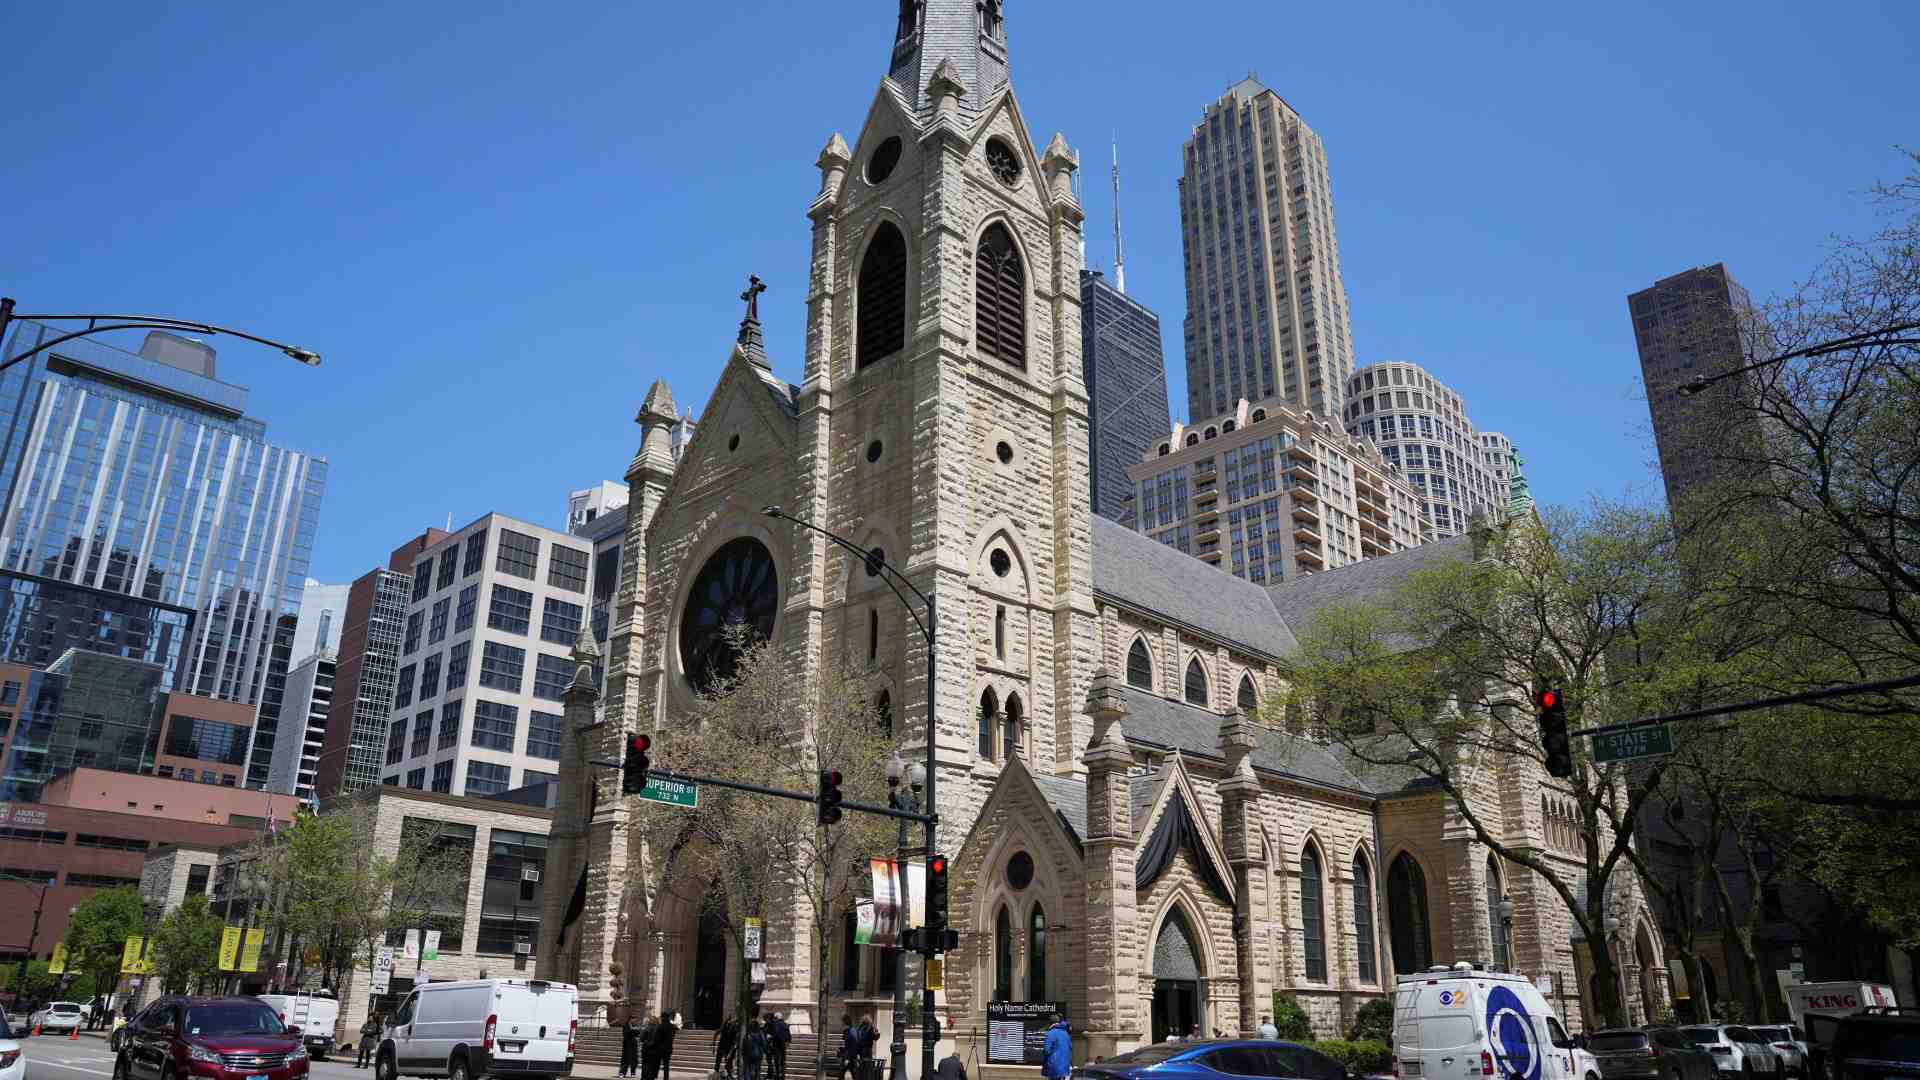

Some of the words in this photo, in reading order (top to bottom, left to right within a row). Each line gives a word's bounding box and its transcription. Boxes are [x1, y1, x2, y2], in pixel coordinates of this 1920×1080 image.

[1608, 730, 1648, 747] STATE
[746, 936, 758, 946] 20
[377, 957, 390, 967] 30
[989, 1002, 1004, 1013] Holy
[1004, 1003, 1023, 1013] Name
[1024, 1001, 1056, 1013] Cathedral
[1807, 994, 1857, 1009] KING
